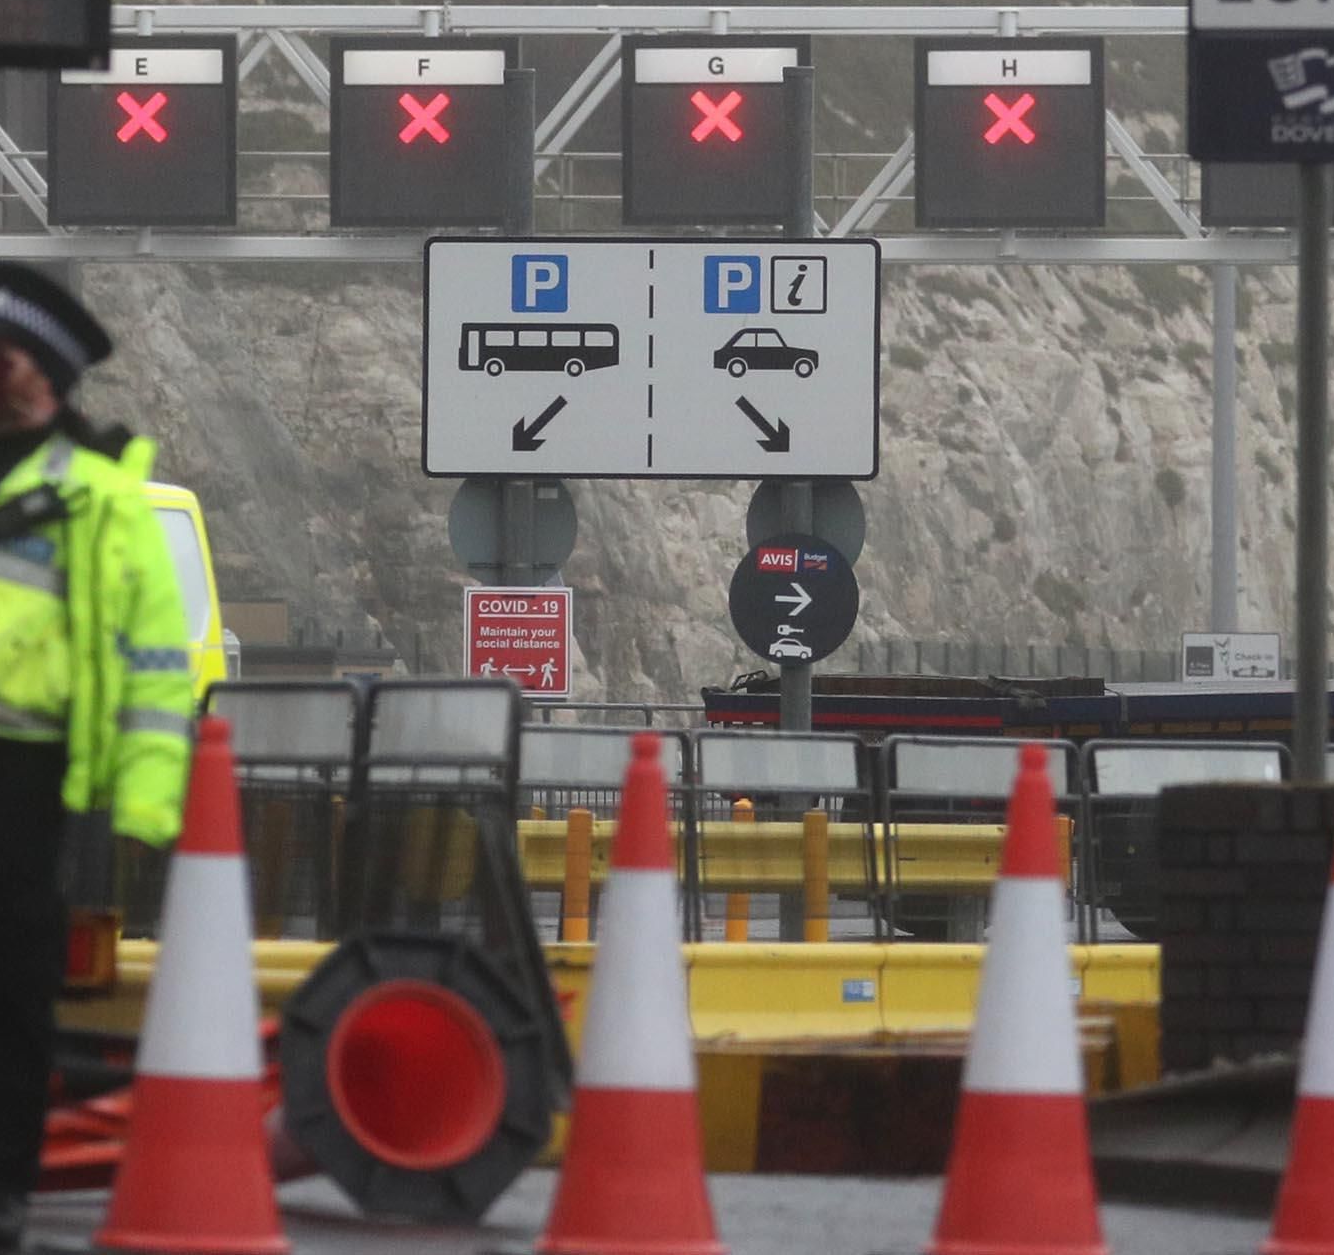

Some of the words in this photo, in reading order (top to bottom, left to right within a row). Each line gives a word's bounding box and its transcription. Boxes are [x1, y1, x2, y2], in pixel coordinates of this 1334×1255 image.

[135, 57, 148, 76] E
[418, 58, 430, 77] F
[708, 56, 724, 76] G
[1002, 59, 1018, 78] H
[525, 261, 560, 307] P
[718, 262, 753, 308] P
[761, 553, 793, 566] AVIS
[803, 553, 828, 562] Budget
[478, 600, 528, 613] COVID
[542, 600, 559, 613] 19
[480, 626, 528, 637] Maintain
[530, 628, 556, 639] your
[475, 638, 510, 649] social
[512, 638, 560, 649] distance
